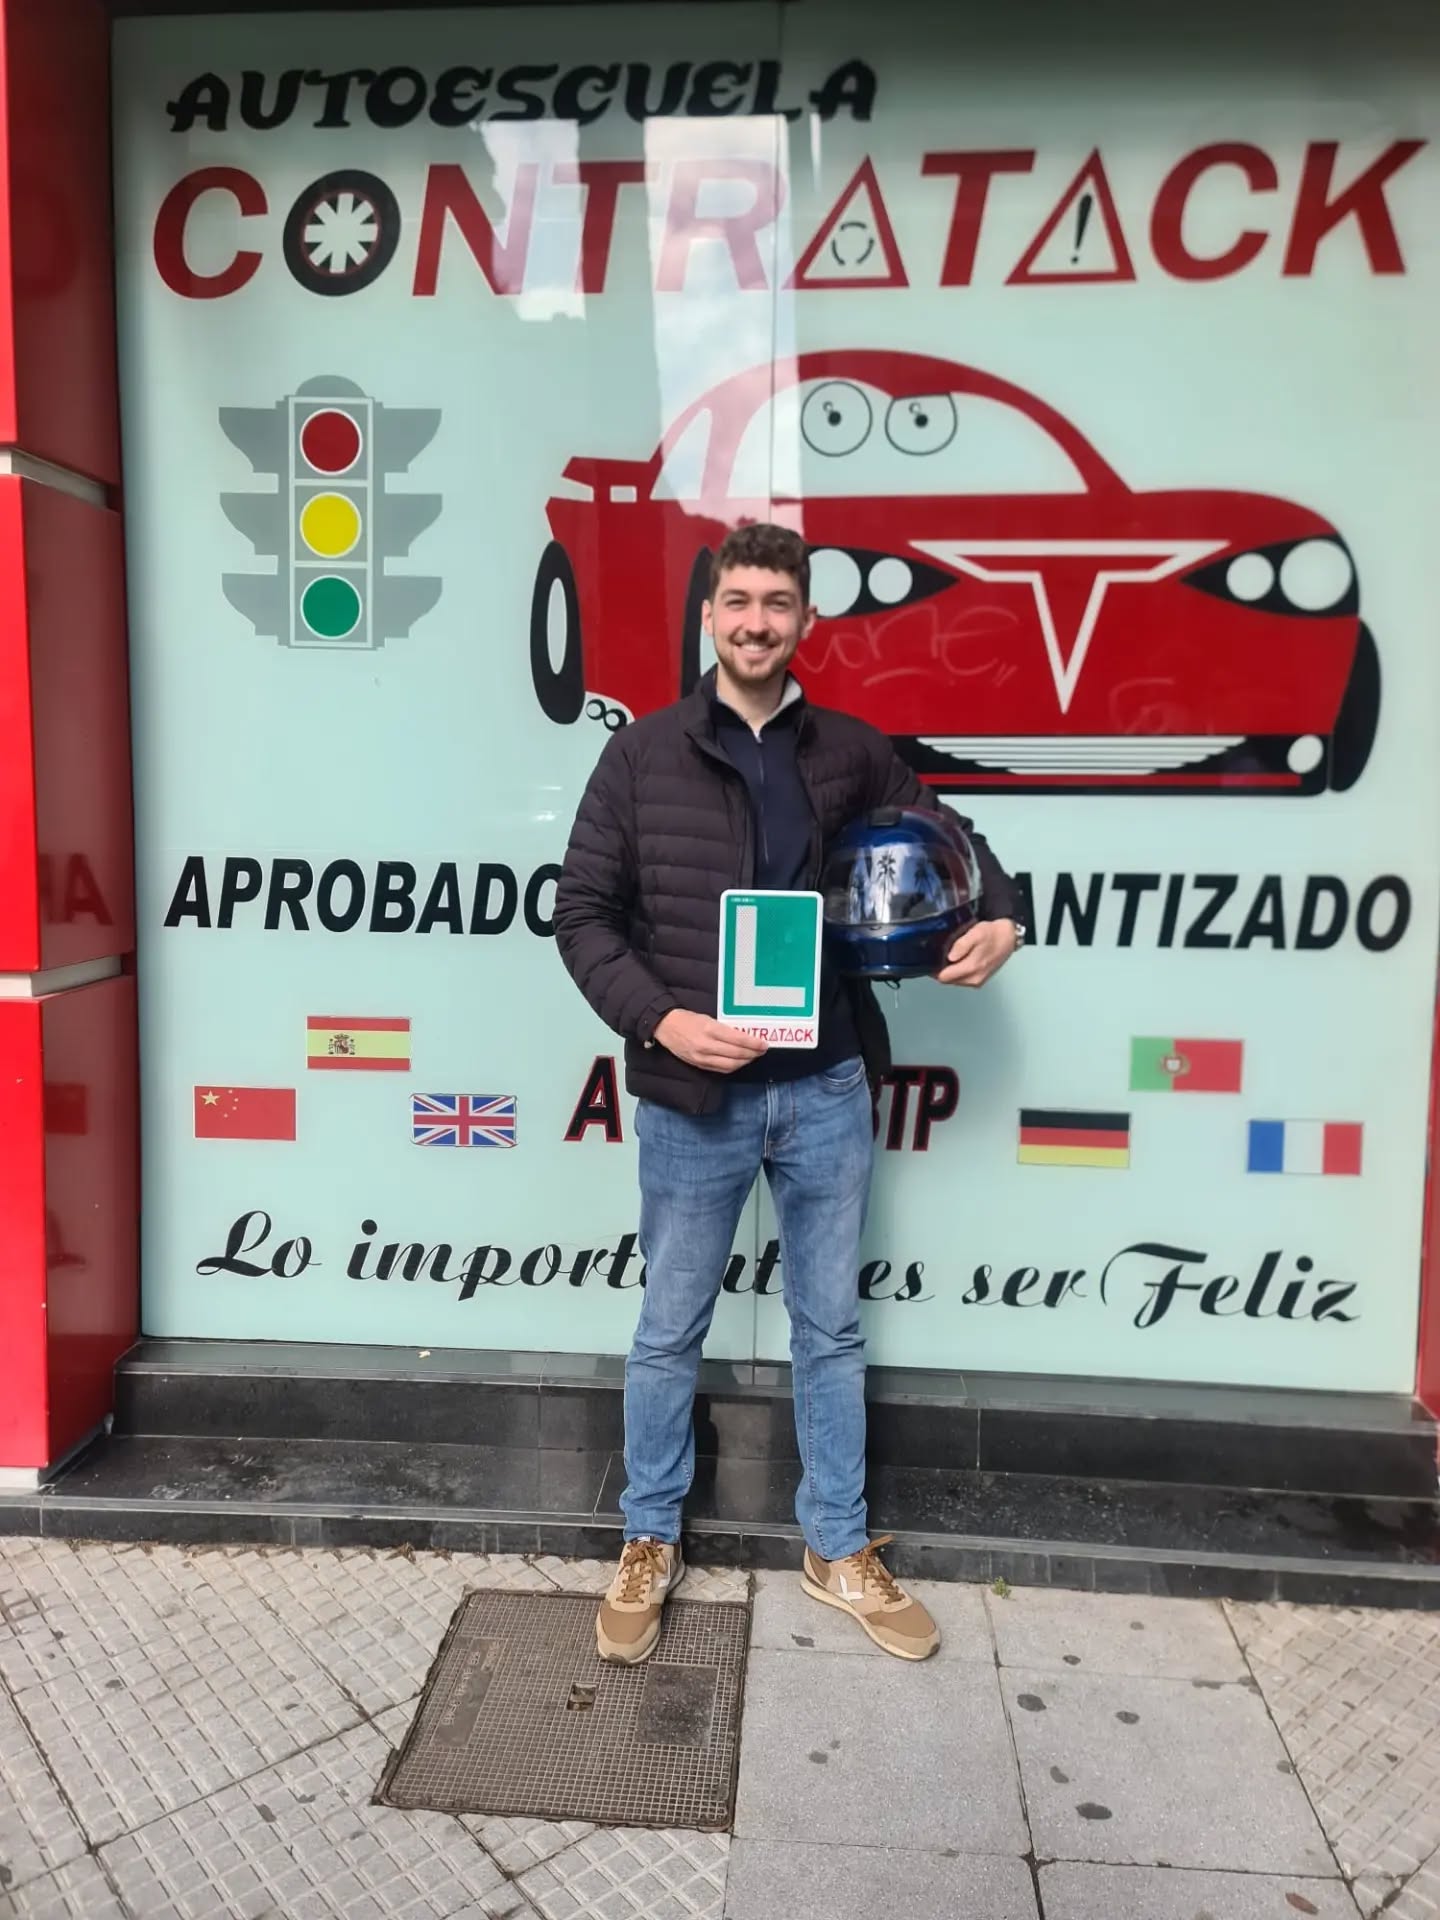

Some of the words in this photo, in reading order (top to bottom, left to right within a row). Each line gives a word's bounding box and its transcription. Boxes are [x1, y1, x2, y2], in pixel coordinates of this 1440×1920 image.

[166, 59, 877, 132] AUTOESCUELA
[153, 139, 1429, 299] CONTRATACK
[164, 856, 562, 938] APROBADO
[1015, 872, 1411, 951] NTIZADO
[733, 905, 806, 1008] L
[734, 1026, 814, 1043] TRATACK
[873, 1066, 960, 1152] TP
[196, 1211, 322, 1278] Lo
[346, 1219, 785, 1301] importnt
[858, 1260, 935, 1303] es
[962, 1264, 1088, 1309] ser
[1100, 1242, 1362, 1329] Feliz
